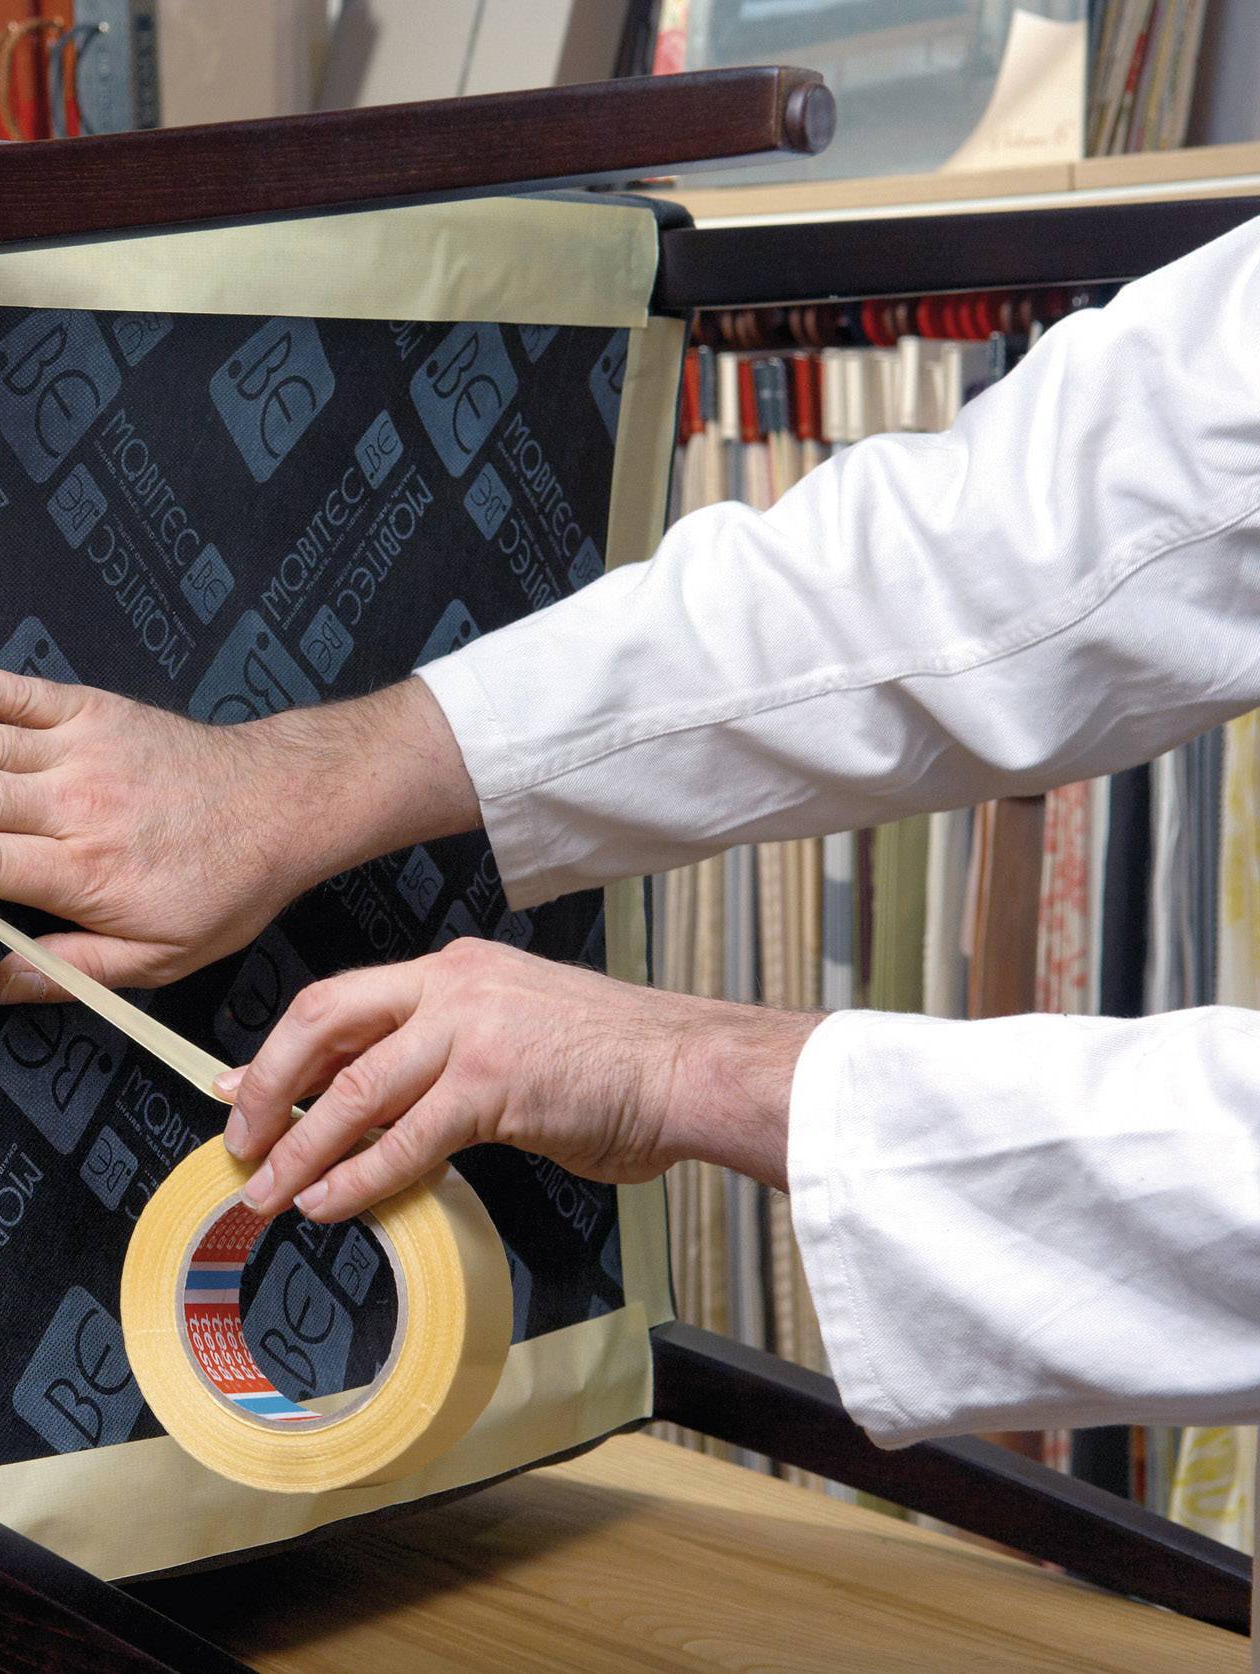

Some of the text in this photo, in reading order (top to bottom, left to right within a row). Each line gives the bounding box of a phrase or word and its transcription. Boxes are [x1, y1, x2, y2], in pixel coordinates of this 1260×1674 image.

[101, 408, 200, 566] MOBITEC
[502, 411, 582, 557] MOBITEC
[260, 466, 365, 622] MOBITEC
[336, 474, 434, 626] MOBITEC
[499, 518, 558, 612] BITEC
[88, 524, 189, 681] MOBITEC
[120, 1065, 201, 1157] MOBIT
[190, 1313, 222, 1381] tesa
[201, 1313, 234, 1380] tesa
[212, 1313, 245, 1380] tesa
[224, 1313, 256, 1379] tesa
